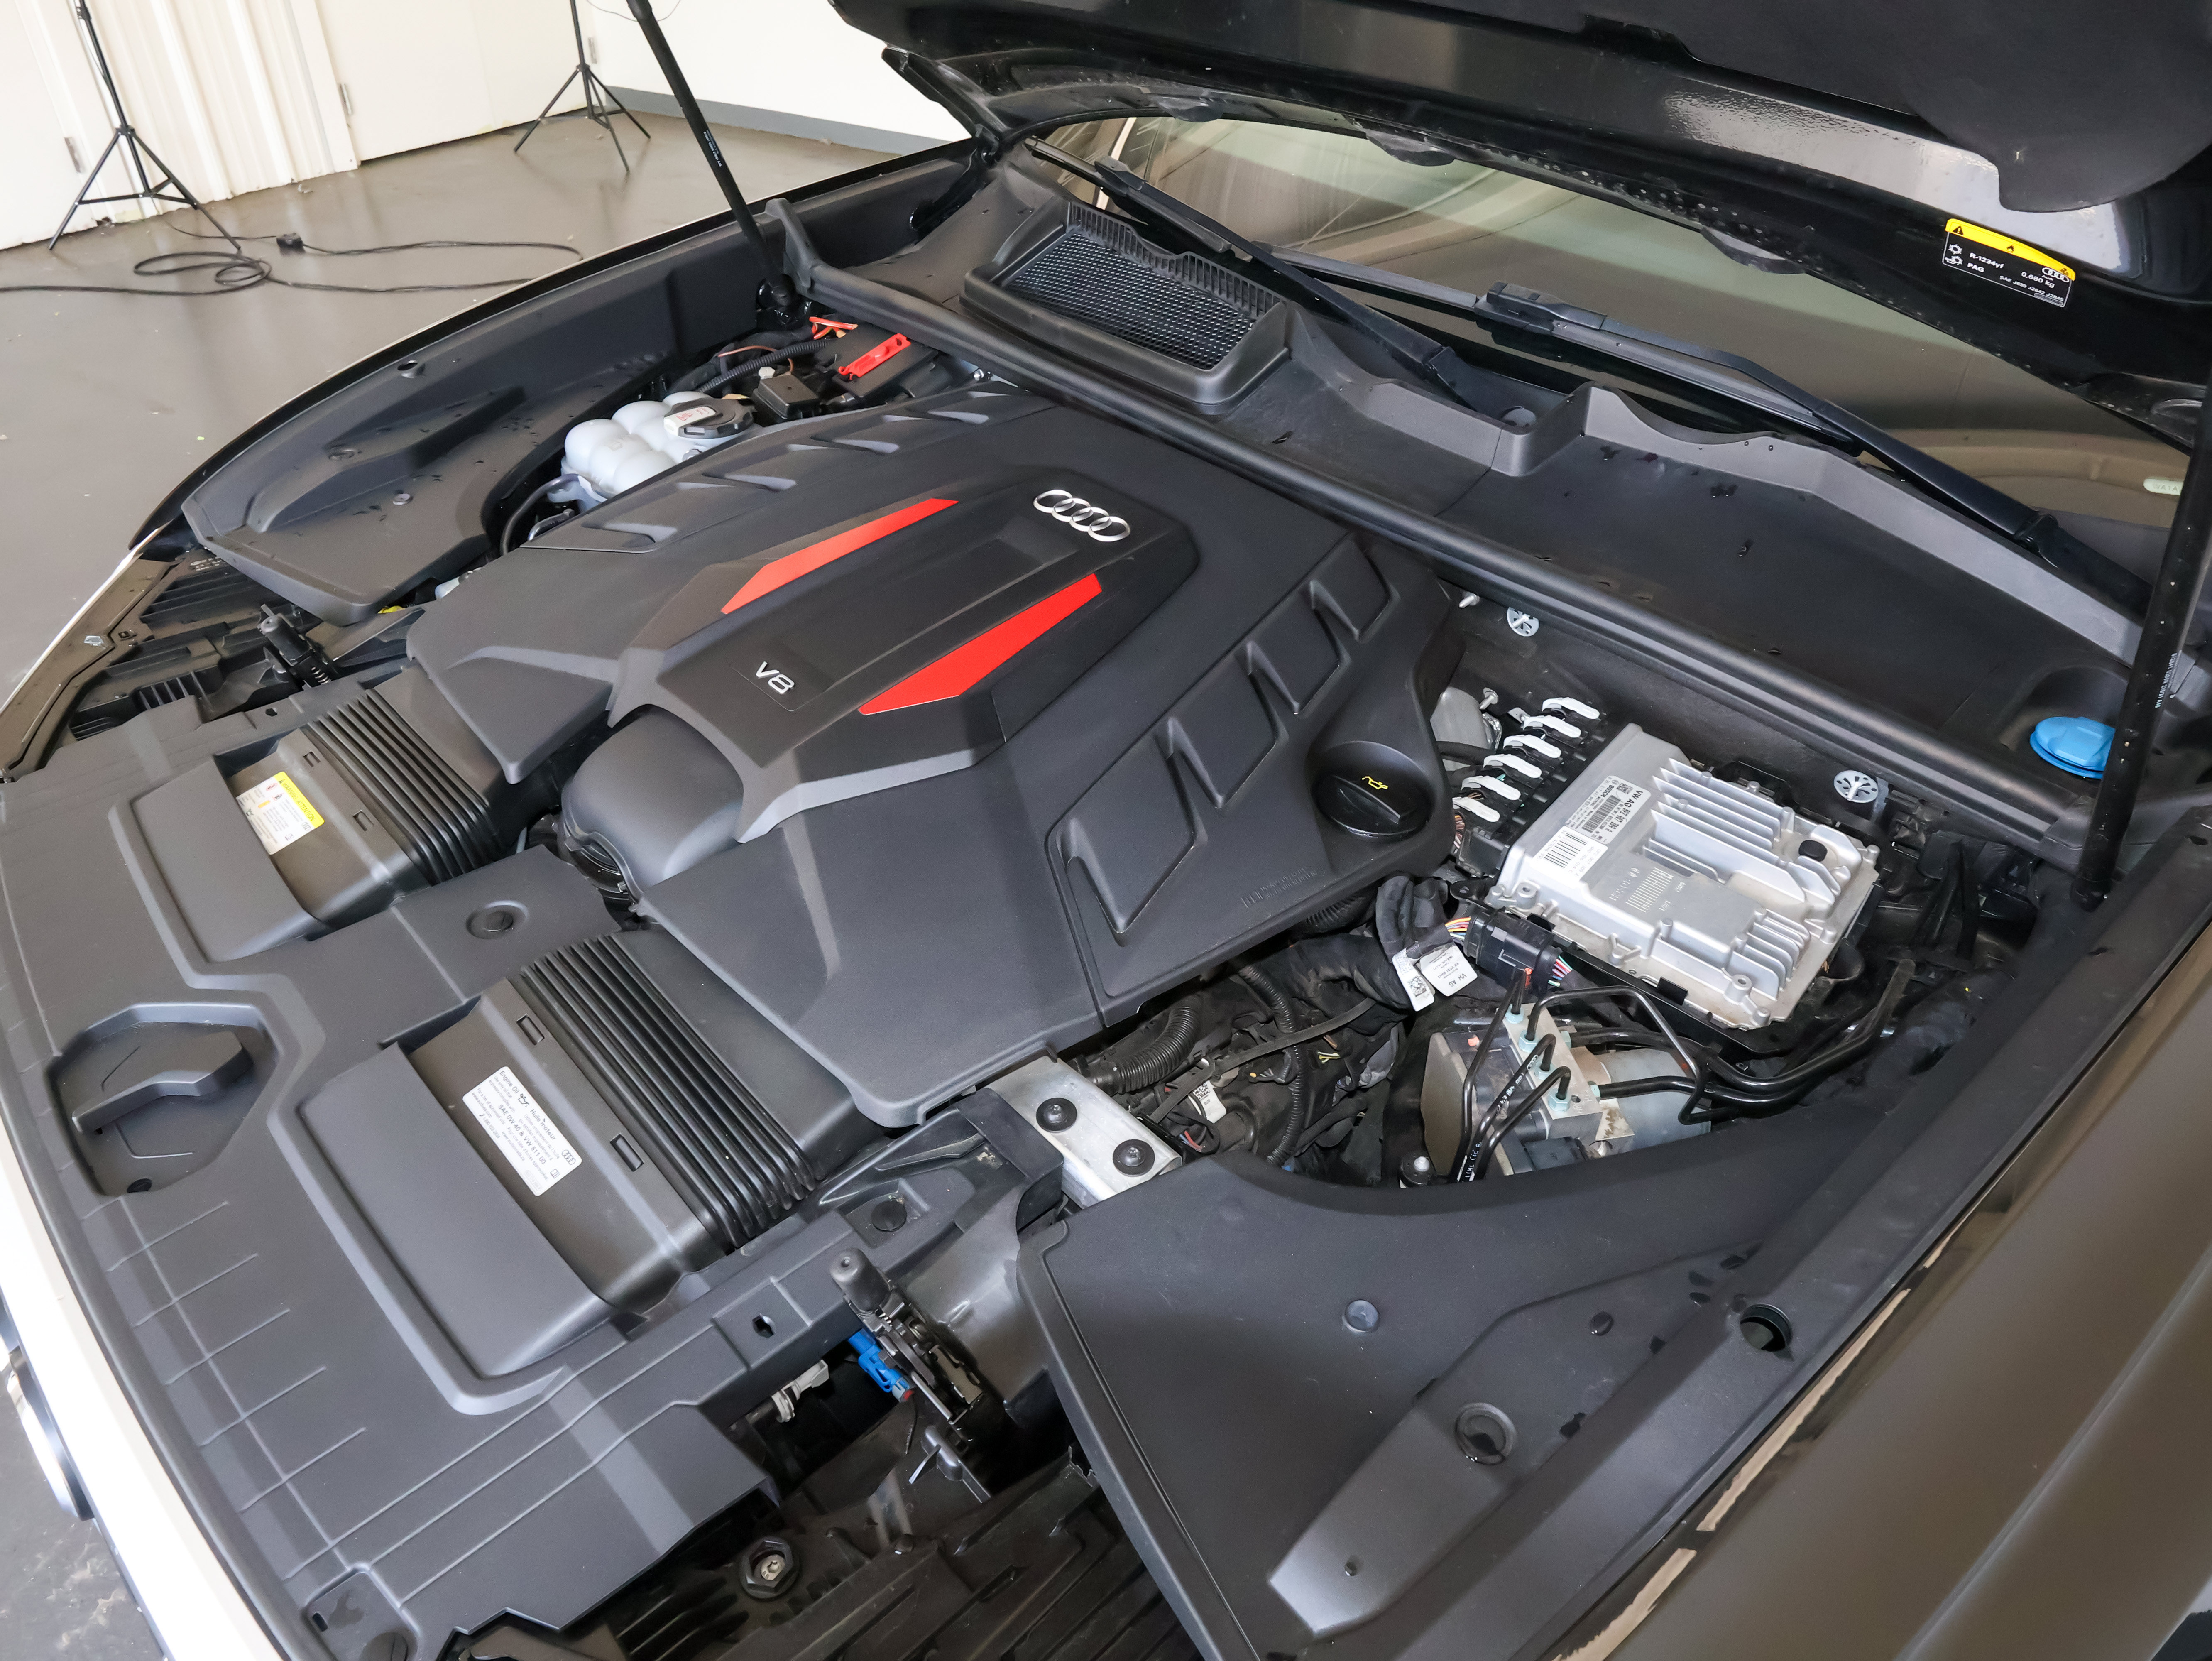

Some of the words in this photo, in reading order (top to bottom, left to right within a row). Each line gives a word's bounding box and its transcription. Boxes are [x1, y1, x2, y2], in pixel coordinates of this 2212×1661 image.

[1968, 252, 2004, 270] R-1234yf
[1966, 262, 1985, 273] PAG
[1999, 275, 2012, 283] SAE
[2020, 270, 2044, 284] 0,680
[2043, 279, 2056, 289] kg
[756, 661, 795, 694] V8
[1600, 784, 1615, 798] BOSCH
[1630, 789, 1643, 800] VW
[282, 782, 298, 800] WARNING
[296, 798, 316, 822] ATTENTION
[1622, 798, 1636, 808] AG
[1436, 970, 1447, 979] Gen2
[1457, 972, 1467, 982] VW
[1448, 979, 1457, 988] AG
[497, 1080, 505, 1090] only
[498, 1070, 514, 1088] Engine
[511, 1085, 520, 1094] Oil
[488, 1103, 502, 1119] approved
[529, 1108, 542, 1123] Huile
[539, 1120, 556, 1141] moteur
[497, 1103, 509, 1116] SAE
[505, 1113, 522, 1132] 0W-40
[522, 1135, 533, 1147] VW
[530, 1145, 541, 1157] 511
[538, 1155, 547, 1165] 00
[506, 1126, 515, 1136] Pour
